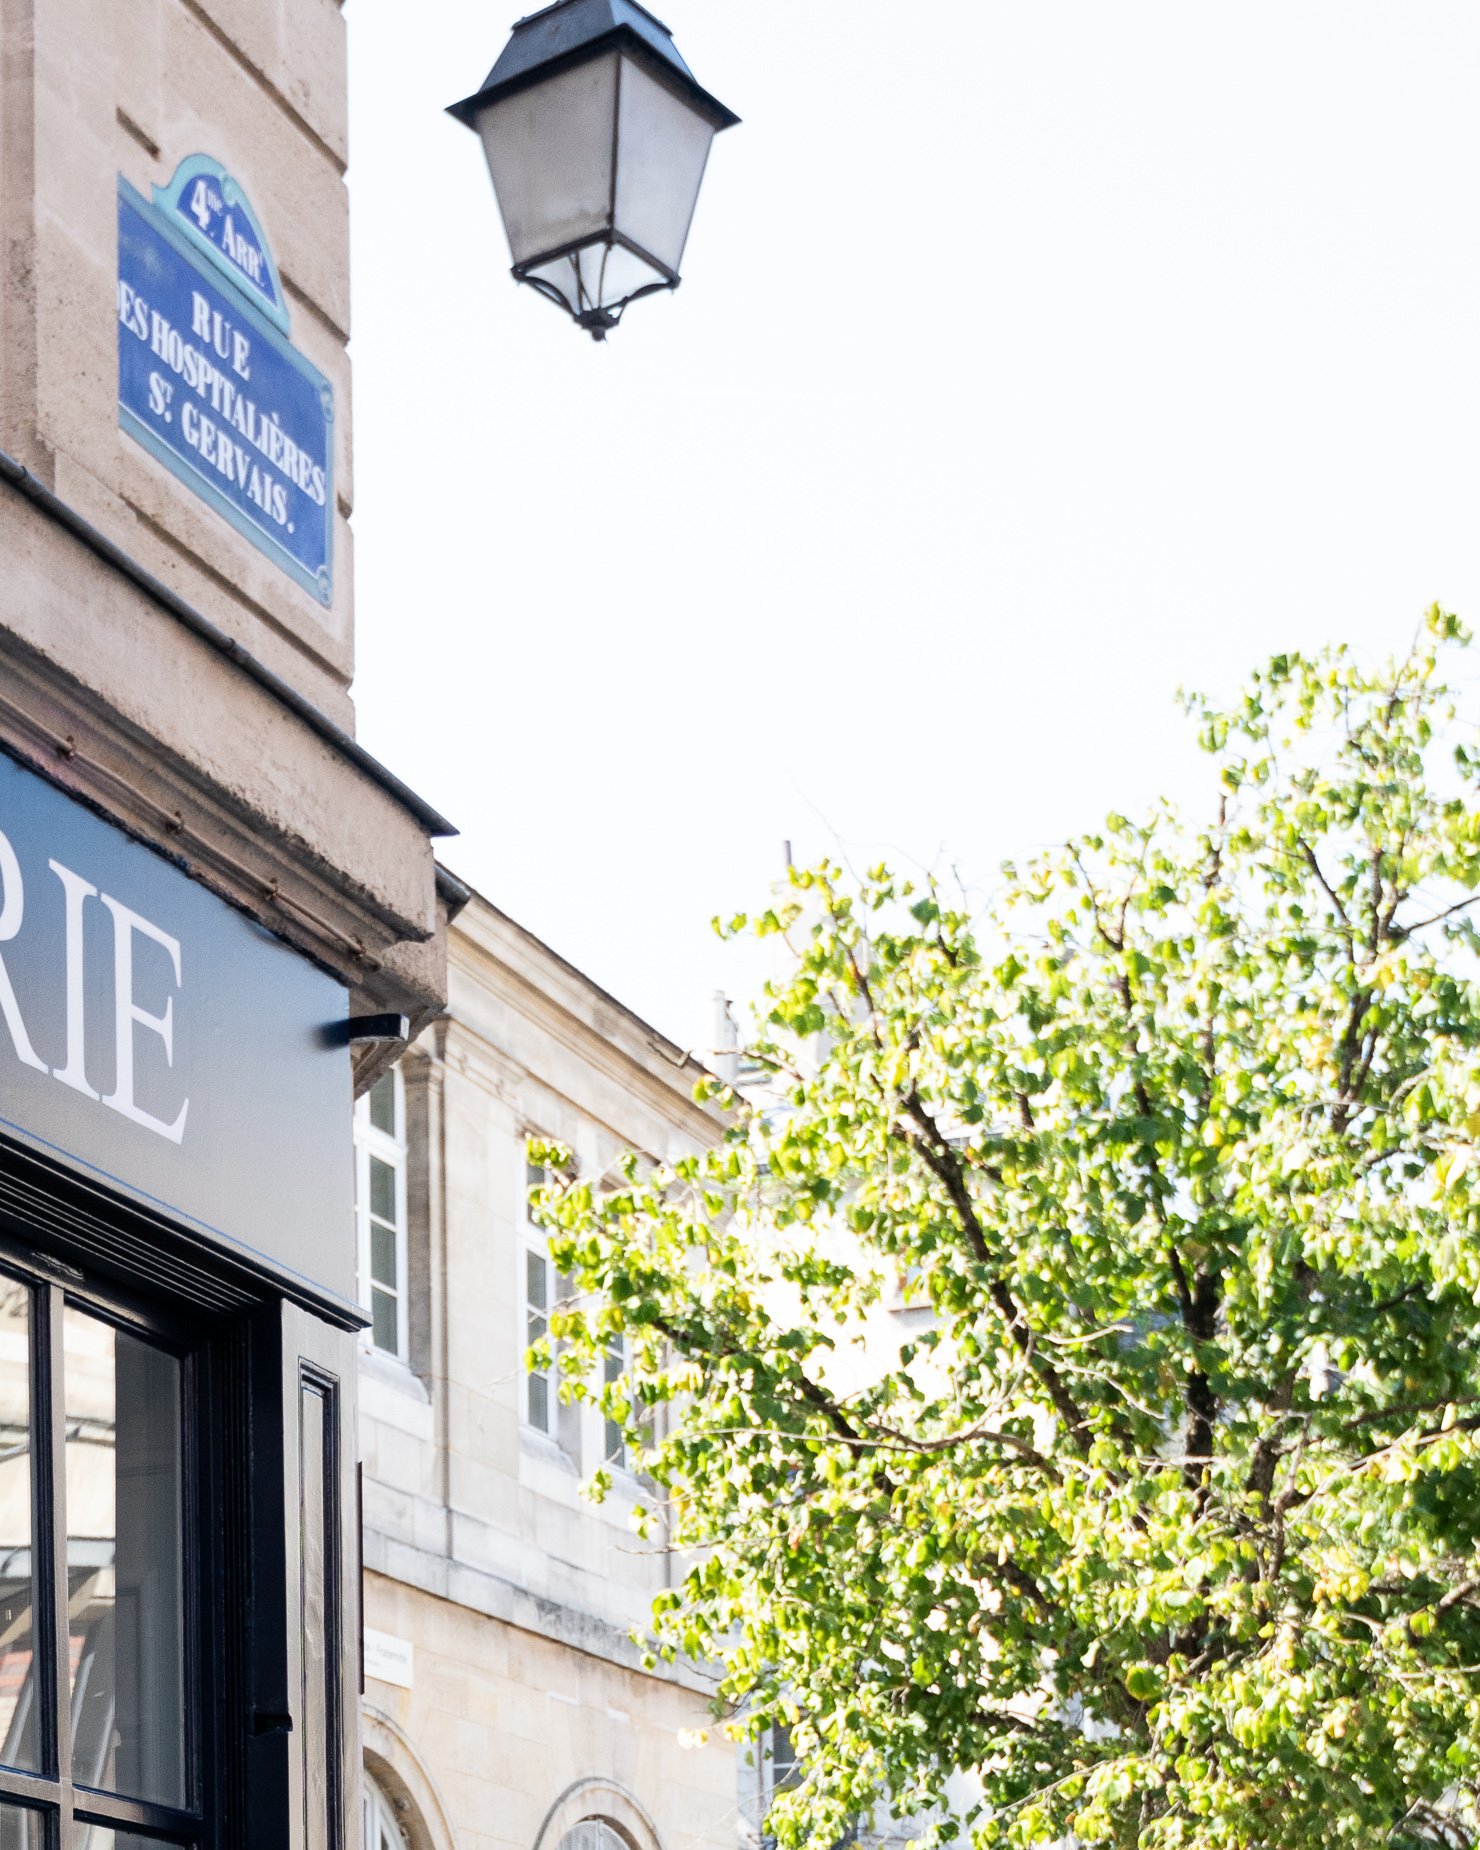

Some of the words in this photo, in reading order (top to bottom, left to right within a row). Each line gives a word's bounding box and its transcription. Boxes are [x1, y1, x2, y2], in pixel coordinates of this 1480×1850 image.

[117, 279, 149, 341] ES
[150, 310, 326, 506] HOSPITALIÈRES
[192, 290, 251, 381] RUE
